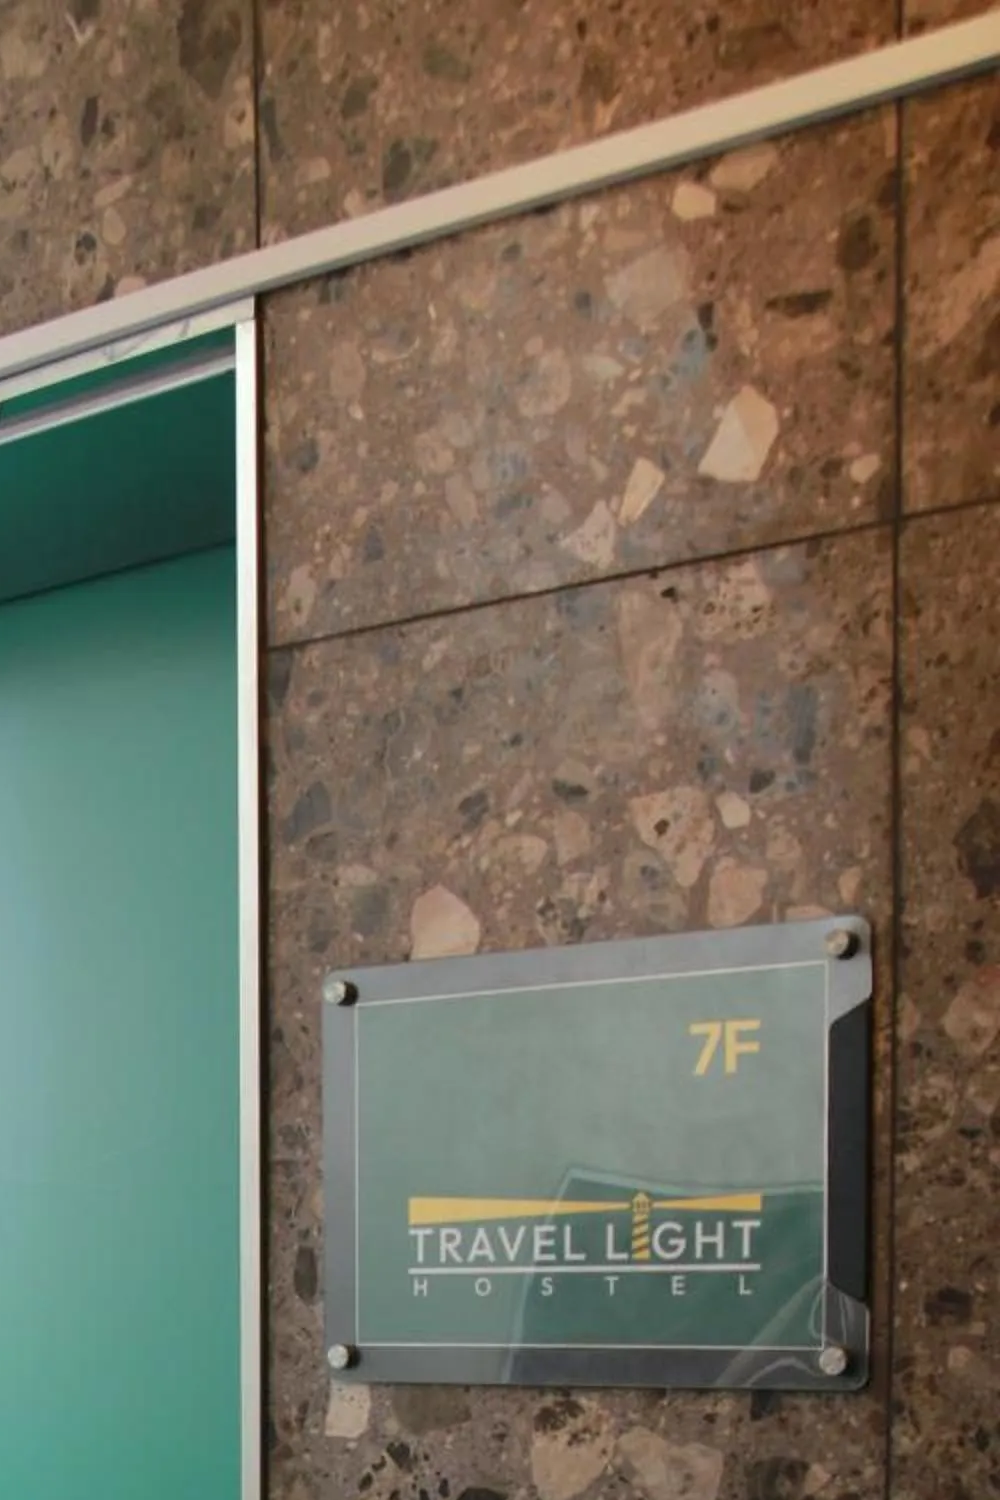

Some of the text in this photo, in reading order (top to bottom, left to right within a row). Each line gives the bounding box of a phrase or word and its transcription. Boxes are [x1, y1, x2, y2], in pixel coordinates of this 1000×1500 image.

[689, 1019, 762, 1076] 7F
[409, 1215, 761, 1264] TRAVEL LIGHT
[413, 1275, 752, 1297] HOSTEL
